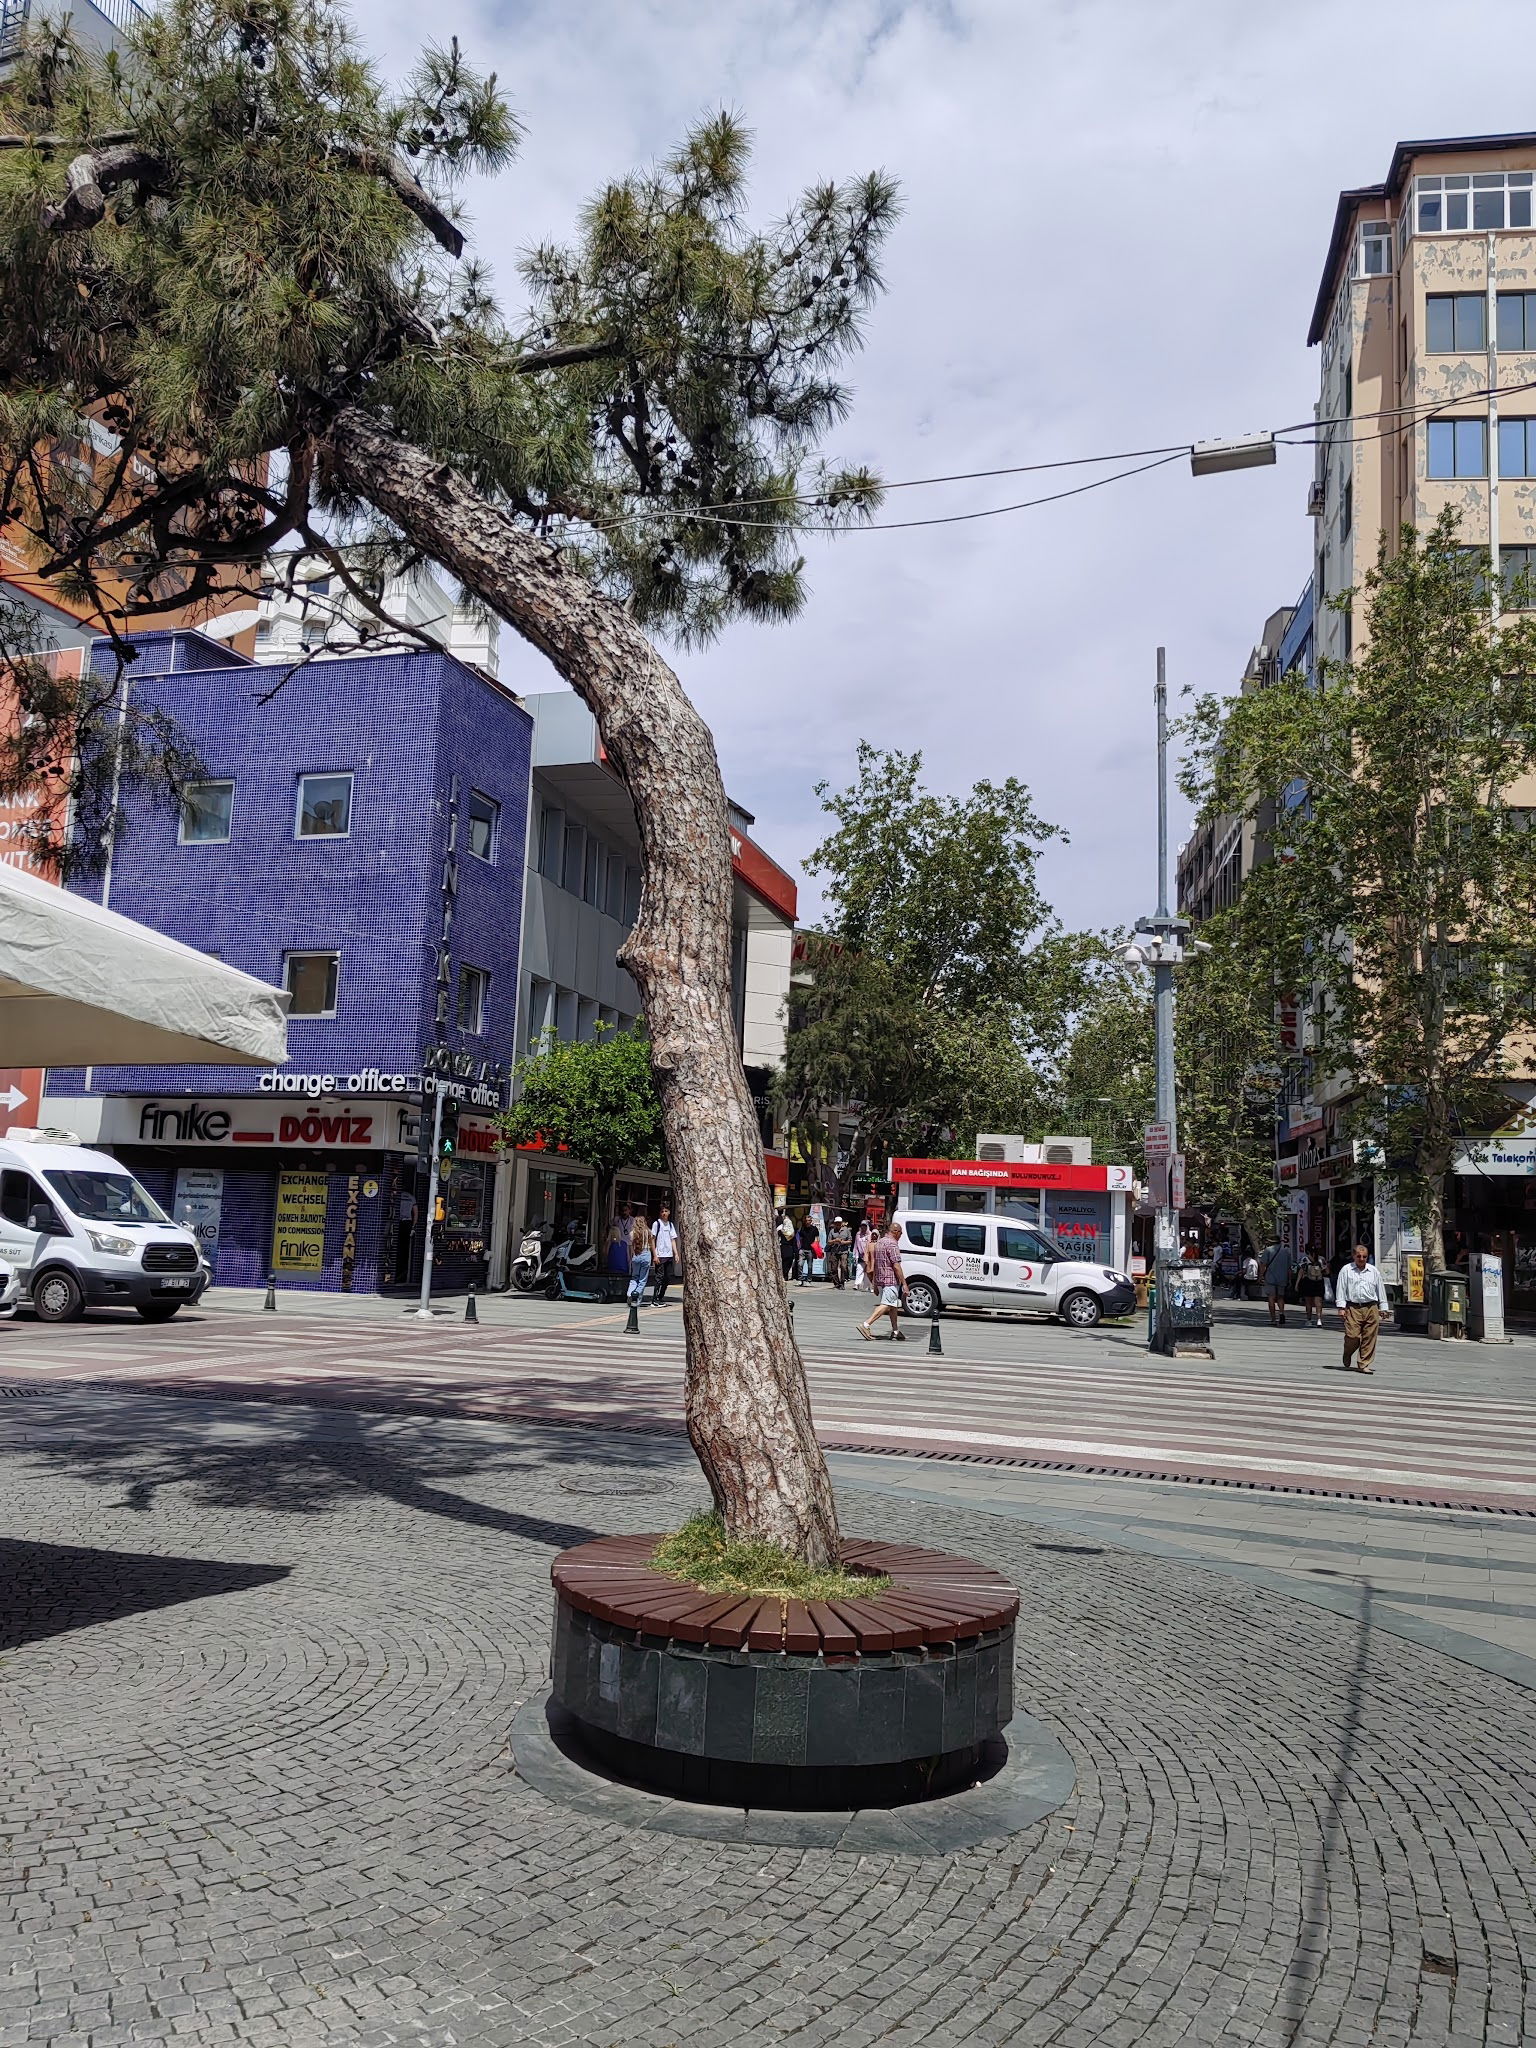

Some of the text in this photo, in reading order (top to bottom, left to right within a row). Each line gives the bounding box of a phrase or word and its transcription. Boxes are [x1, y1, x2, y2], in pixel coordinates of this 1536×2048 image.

[260, 1068, 406, 1097] change office
[471, 1082, 500, 1109] office
[279, 1107, 373, 1143] DÖVİZ
[1492, 1153, 1536, 1164] Telekom
[952, 1169, 968, 1177] KAN
[969, 1169, 1009, 1178] BAĞIŞINDA
[281, 1175, 329, 1185] EXCHANGE
[283, 1193, 326, 1205] WECHSEL
[277, 1226, 287, 1234] NO
[1057, 1222, 1097, 1238] KAN
